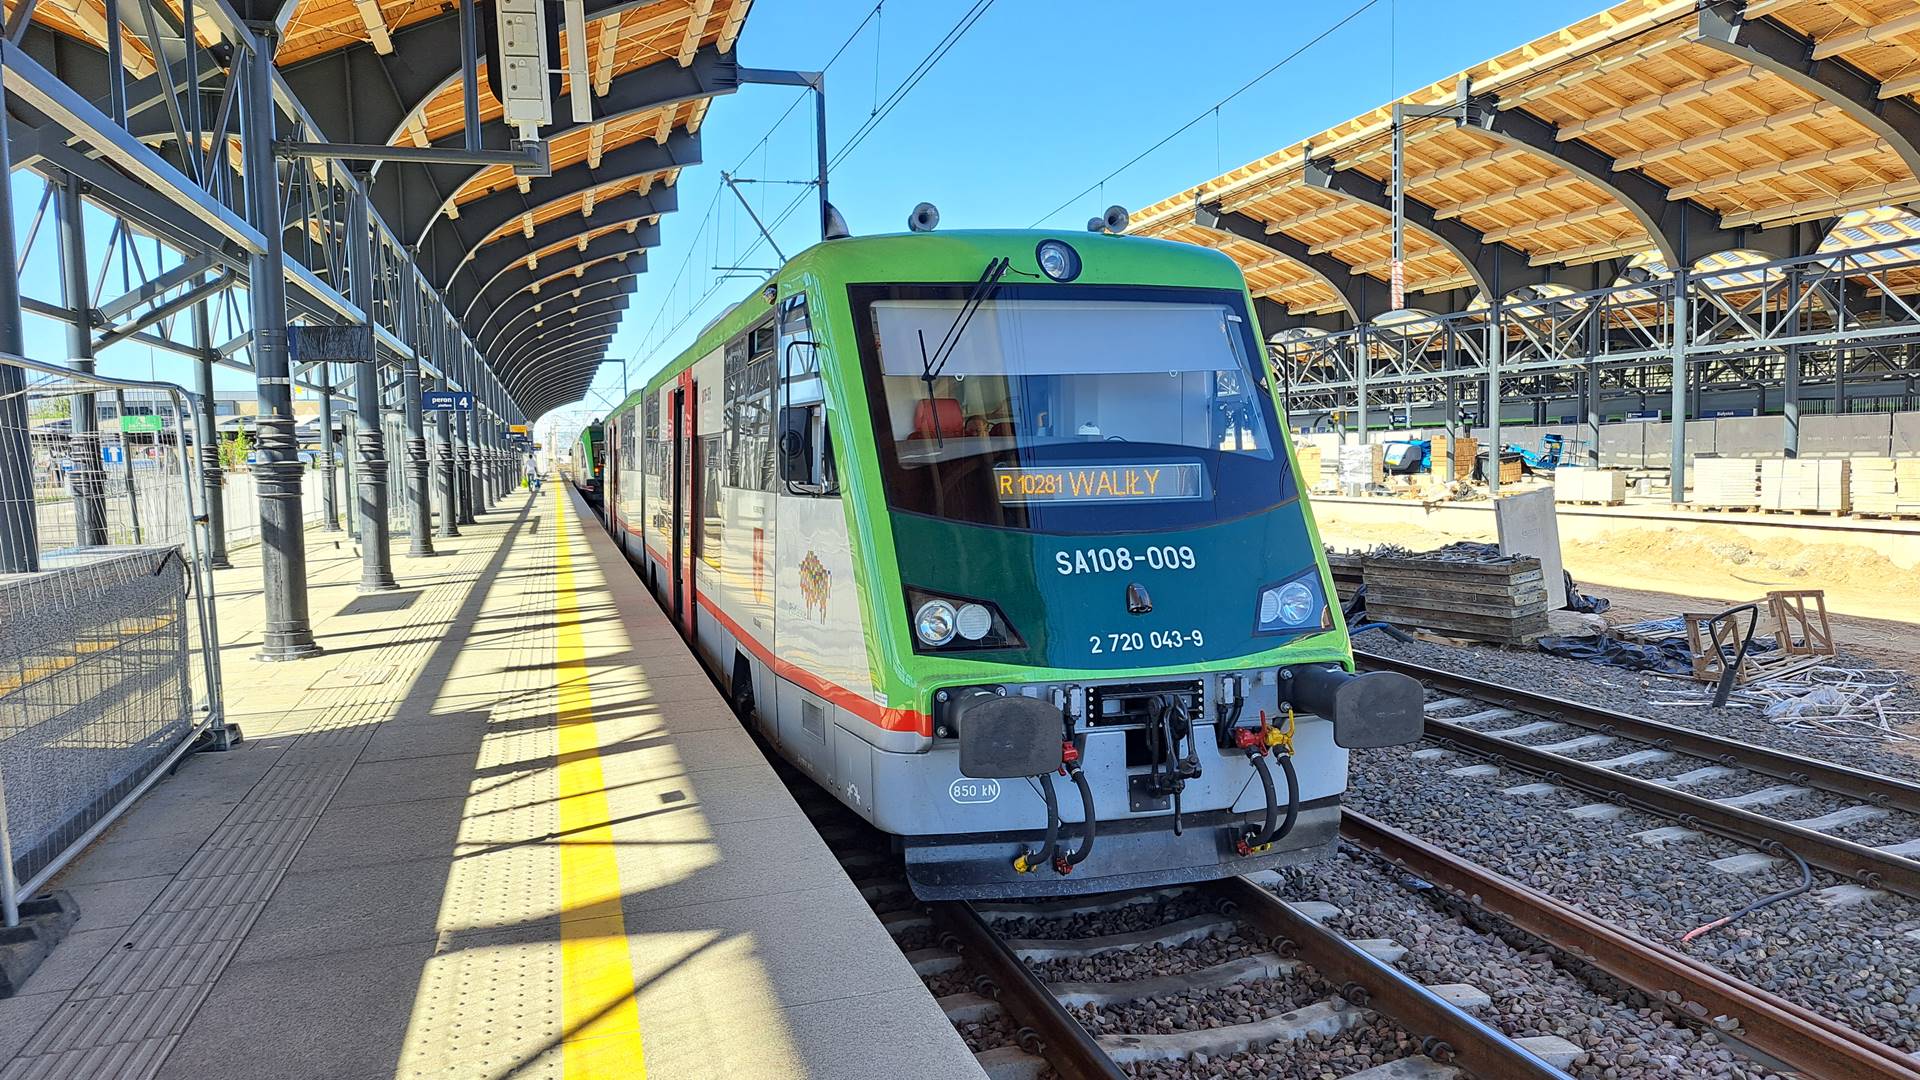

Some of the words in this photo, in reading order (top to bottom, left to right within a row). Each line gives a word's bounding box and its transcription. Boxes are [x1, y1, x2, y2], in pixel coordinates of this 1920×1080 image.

[459, 396, 468, 408] 4
[1000, 475, 1013, 495] R
[1018, 474, 1062, 495] 10281
[1069, 469, 1160, 496] WALIŁY
[1055, 546, 1196, 575] SA108-009
[1089, 636, 1103, 654] 2
[1108, 632, 1144, 652] 720
[1149, 629, 1204, 649] 043-9
[953, 785, 977, 797] 850
[982, 784, 996, 797] kN
